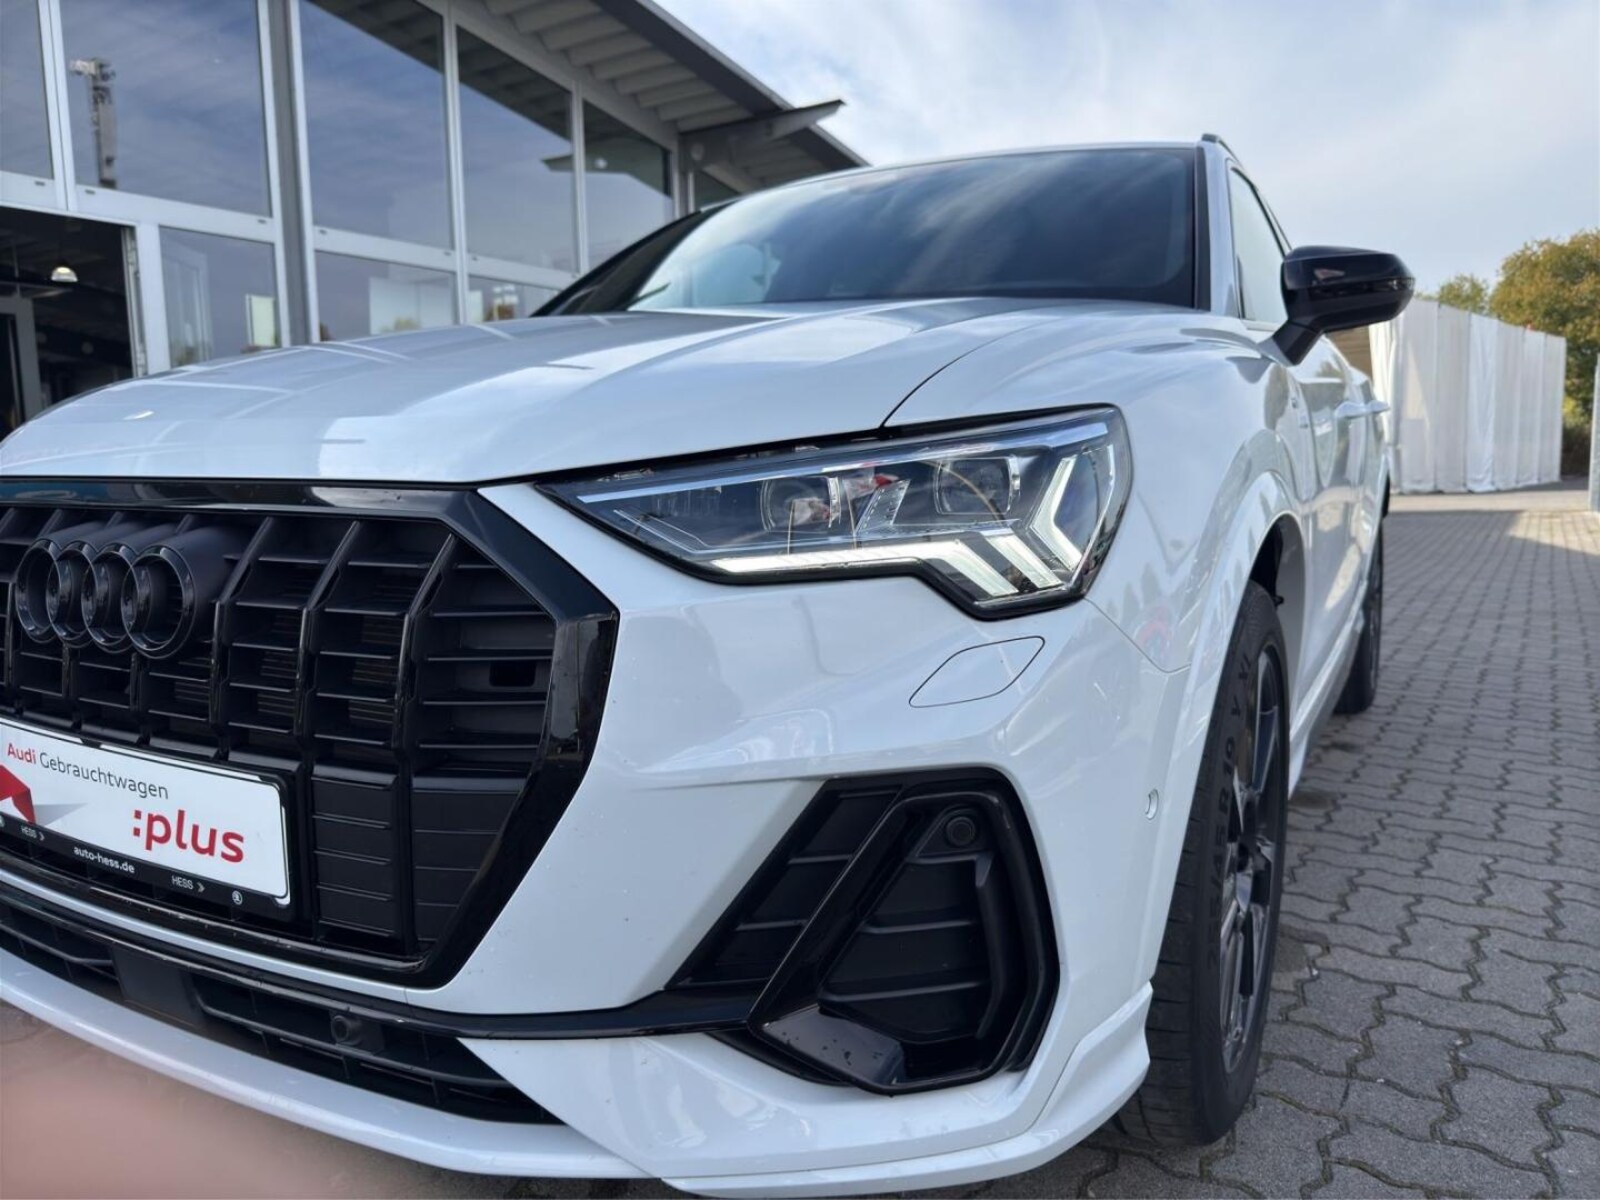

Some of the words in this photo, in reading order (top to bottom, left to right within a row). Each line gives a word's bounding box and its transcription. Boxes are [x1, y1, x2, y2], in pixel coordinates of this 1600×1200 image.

[7, 743, 37, 765] Audi
[39, 752, 169, 800] Gebrauchtwagen
[1219, 787, 1230, 814] R
[73, 846, 136, 874] auto-hess.de
[171, 875, 194, 890] HESS
